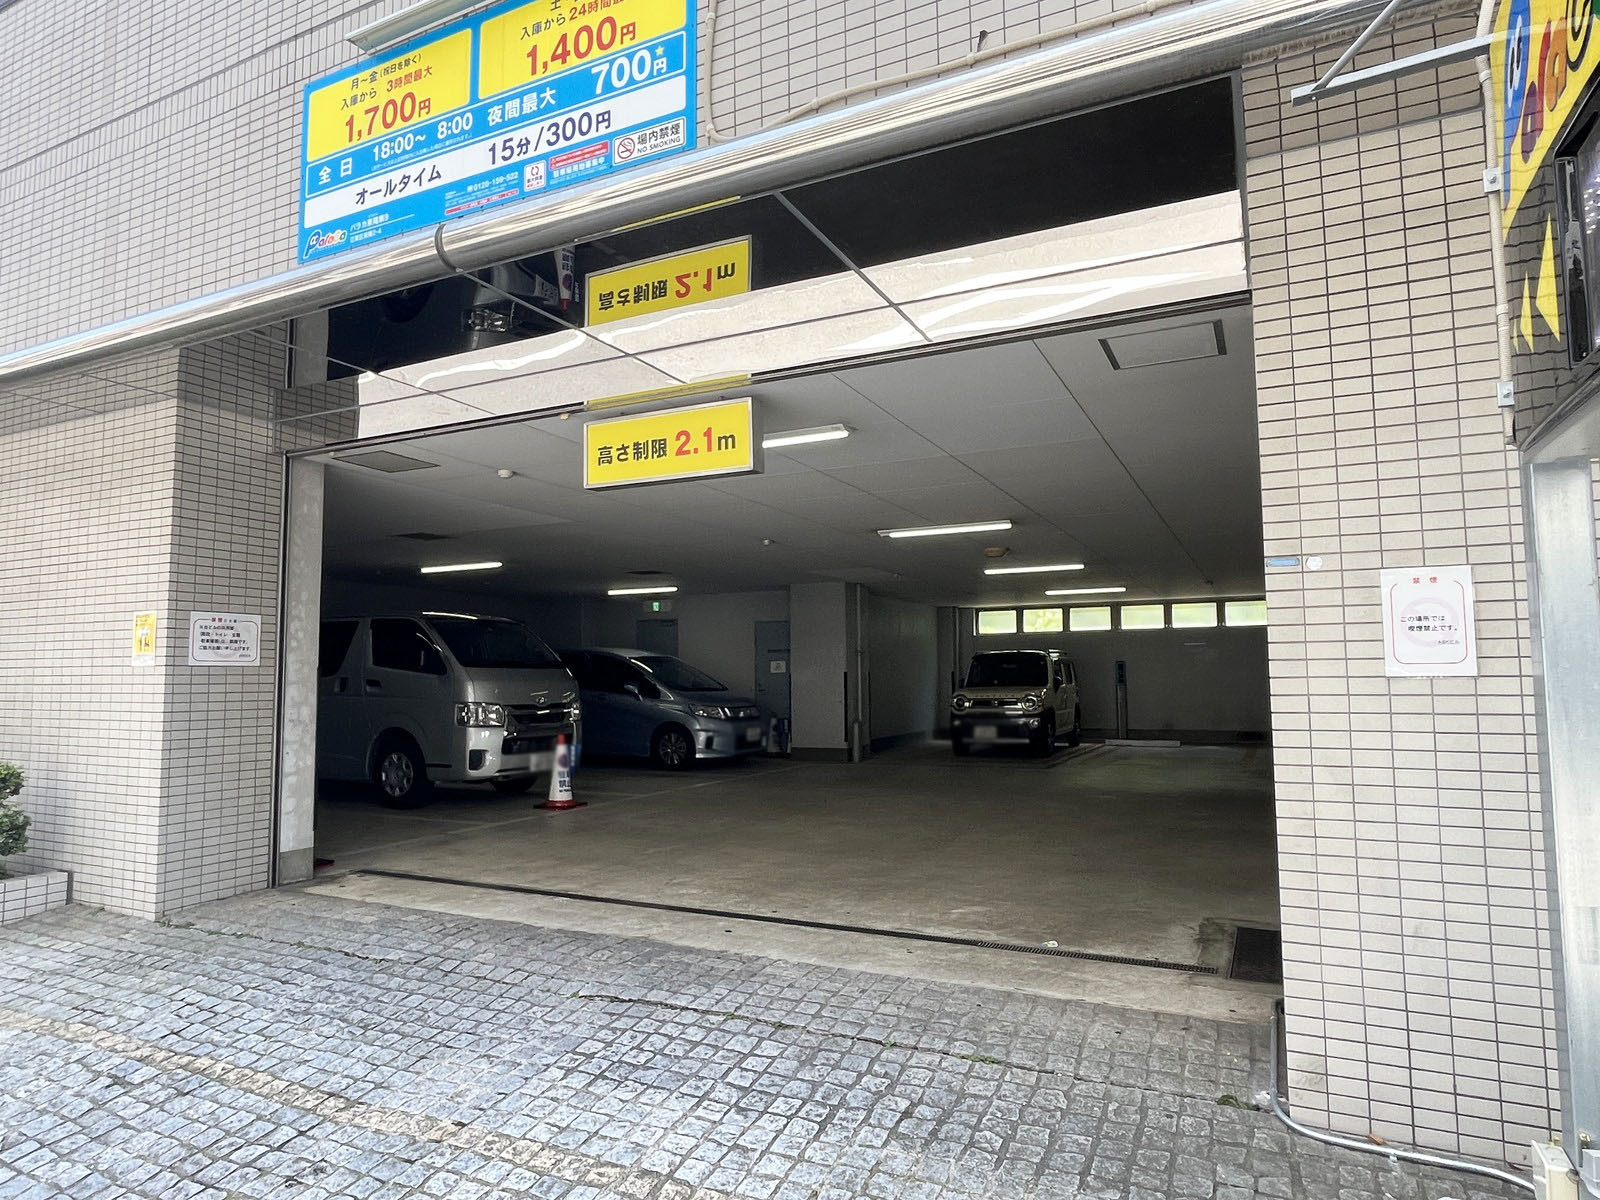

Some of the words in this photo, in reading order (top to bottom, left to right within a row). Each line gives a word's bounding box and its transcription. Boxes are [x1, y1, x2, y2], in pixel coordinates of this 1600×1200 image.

[520, 13, 566, 40] 入庫から
[526, 15, 636, 76] 1,400円
[341, 88, 377, 111] 入庫から
[386, 66, 433, 92] 3時間最大
[437, 112, 473, 139] 8:00
[487, 86, 557, 127] 夜間最大
[591, 49, 667, 95] 700円
[345, 91, 431, 143] 1,700円
[637, 122, 680, 145] 場内禁煙
[637, 146, 648, 154] NO
[649, 137, 681, 152] SMOKING
[355, 164, 442, 205] オールタイム
[597, 437, 667, 466] 高さ制限
[675, 427, 736, 458] 2.1m
[1400, 615, 1446, 623] この場所では
